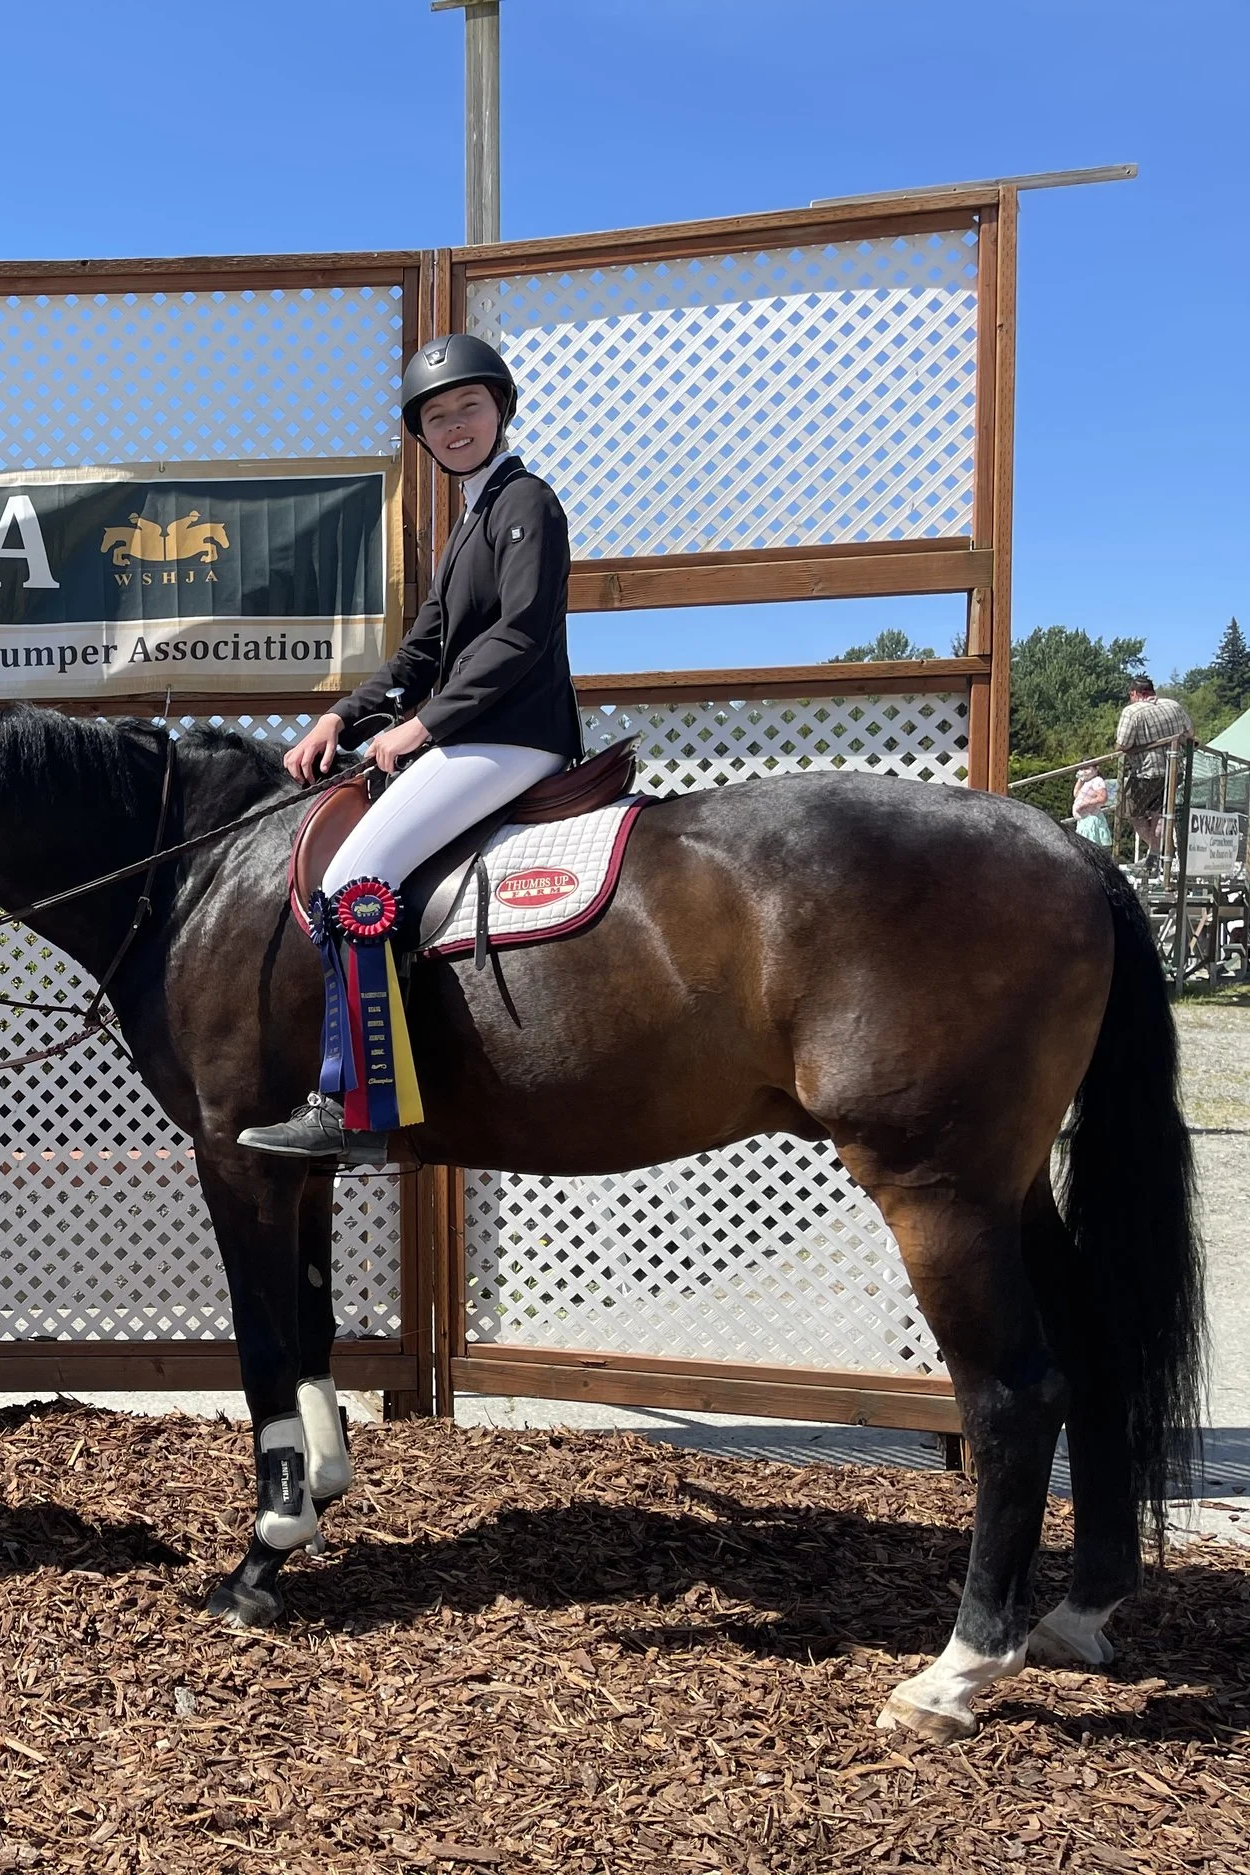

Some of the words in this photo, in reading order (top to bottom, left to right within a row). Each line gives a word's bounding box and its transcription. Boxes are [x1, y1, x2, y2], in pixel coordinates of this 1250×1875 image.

[114, 569, 219, 587] WSHJA
[128, 632, 334, 663] Association
[505, 877, 551, 891] THUMBS
[554, 875, 569, 886] UP
[511, 887, 561, 898] FARM
